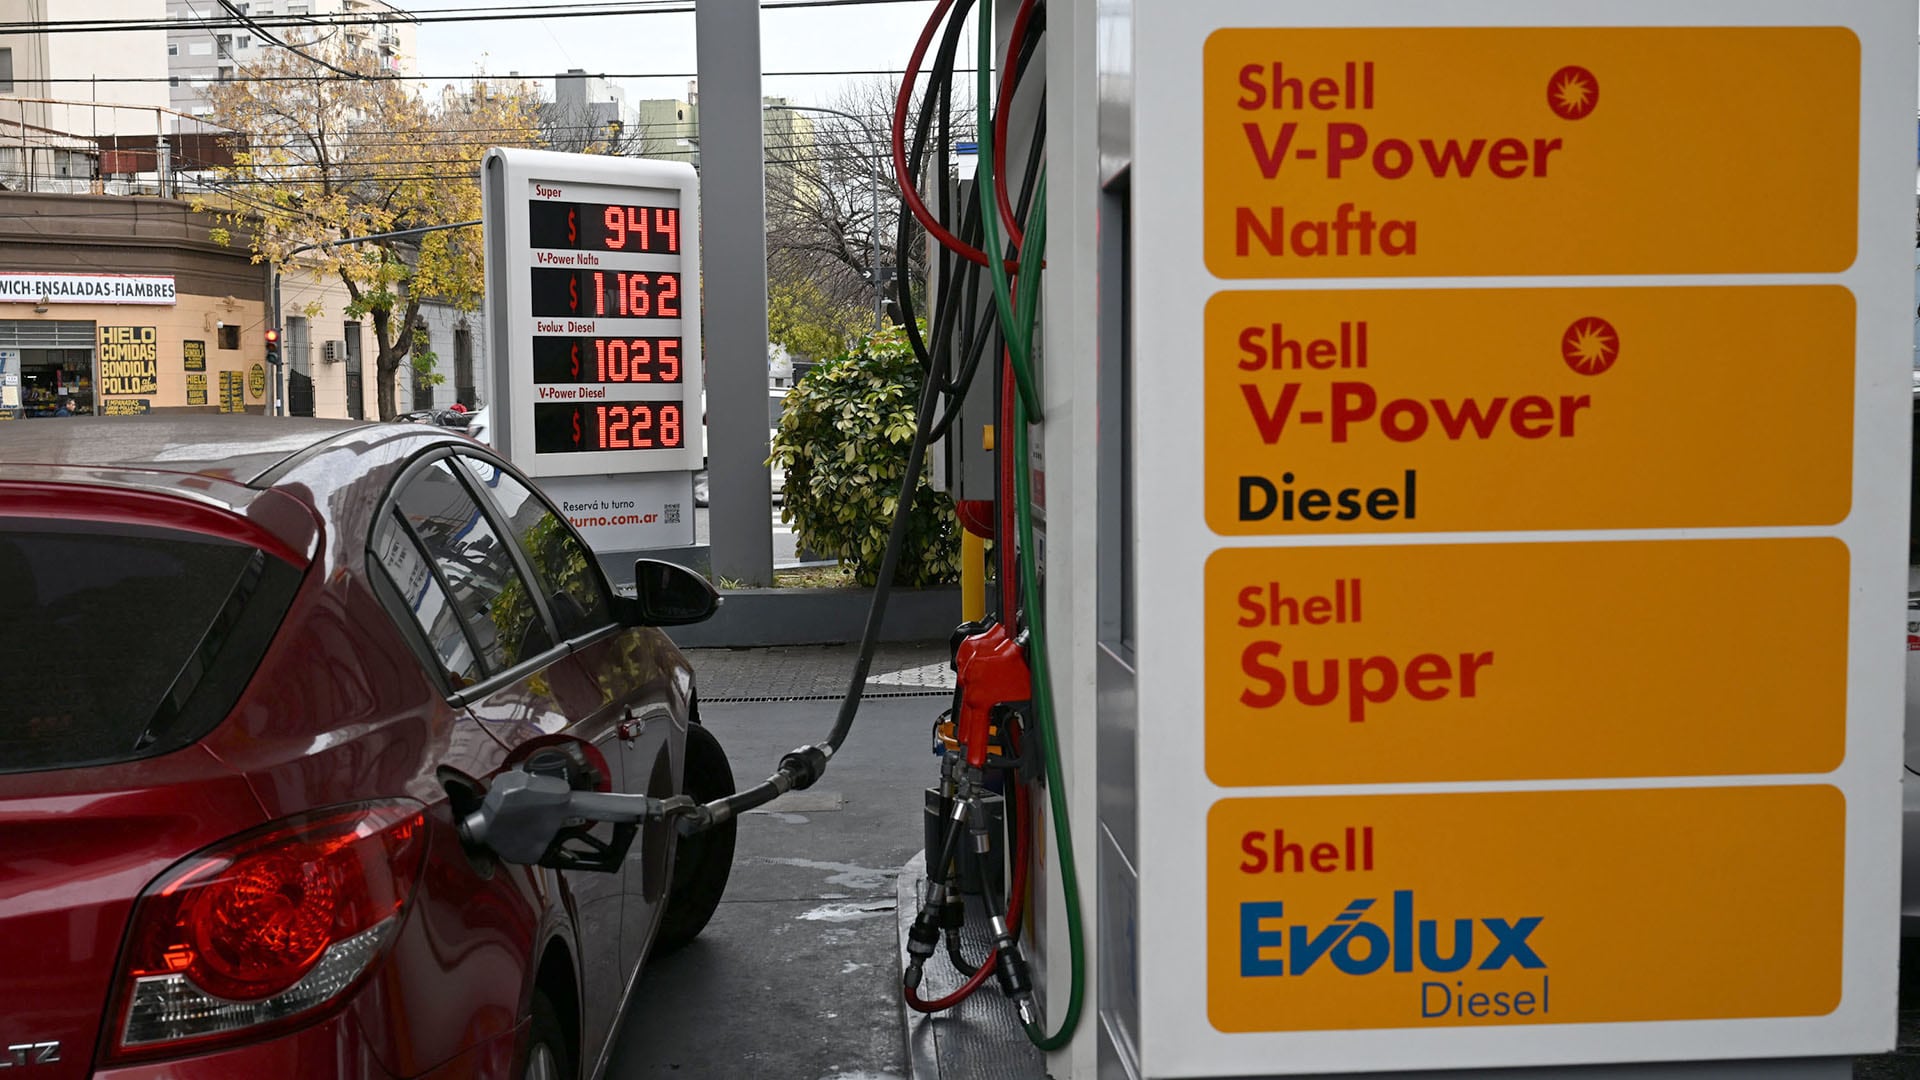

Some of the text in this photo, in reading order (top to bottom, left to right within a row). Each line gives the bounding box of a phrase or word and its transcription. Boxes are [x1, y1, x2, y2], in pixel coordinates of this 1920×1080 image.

[1237, 61, 1374, 111] Shell
[1241, 122, 1563, 180] V-Power
[536, 184, 562, 199] Super
[567, 206, 677, 251] $ 944
[1235, 203, 1417, 257] Nafta
[537, 252, 599, 265] V-Power Nafta
[569, 272, 678, 316] $ 1162
[100, 327, 156, 344] HIELO
[537, 321, 595, 333] Evolux Diesel
[1237, 321, 1368, 371] Shell
[101, 344, 156, 360] COMIDAS
[101, 361, 156, 377] BONDIOLA
[570, 339, 679, 382] $ 1025
[102, 377, 141, 394] POLLO
[539, 386, 606, 399] V-Power Diesel
[572, 405, 680, 448] $ 1228
[1239, 381, 1591, 445] V-Power
[563, 500, 635, 511] Reservá tu turno
[1238, 469, 1416, 522] Diesel
[1237, 578, 1362, 628] Shell
[1239, 640, 1494, 723] Super
[1239, 826, 1374, 875] Shell
[1421, 975, 1549, 1018] Diesel
